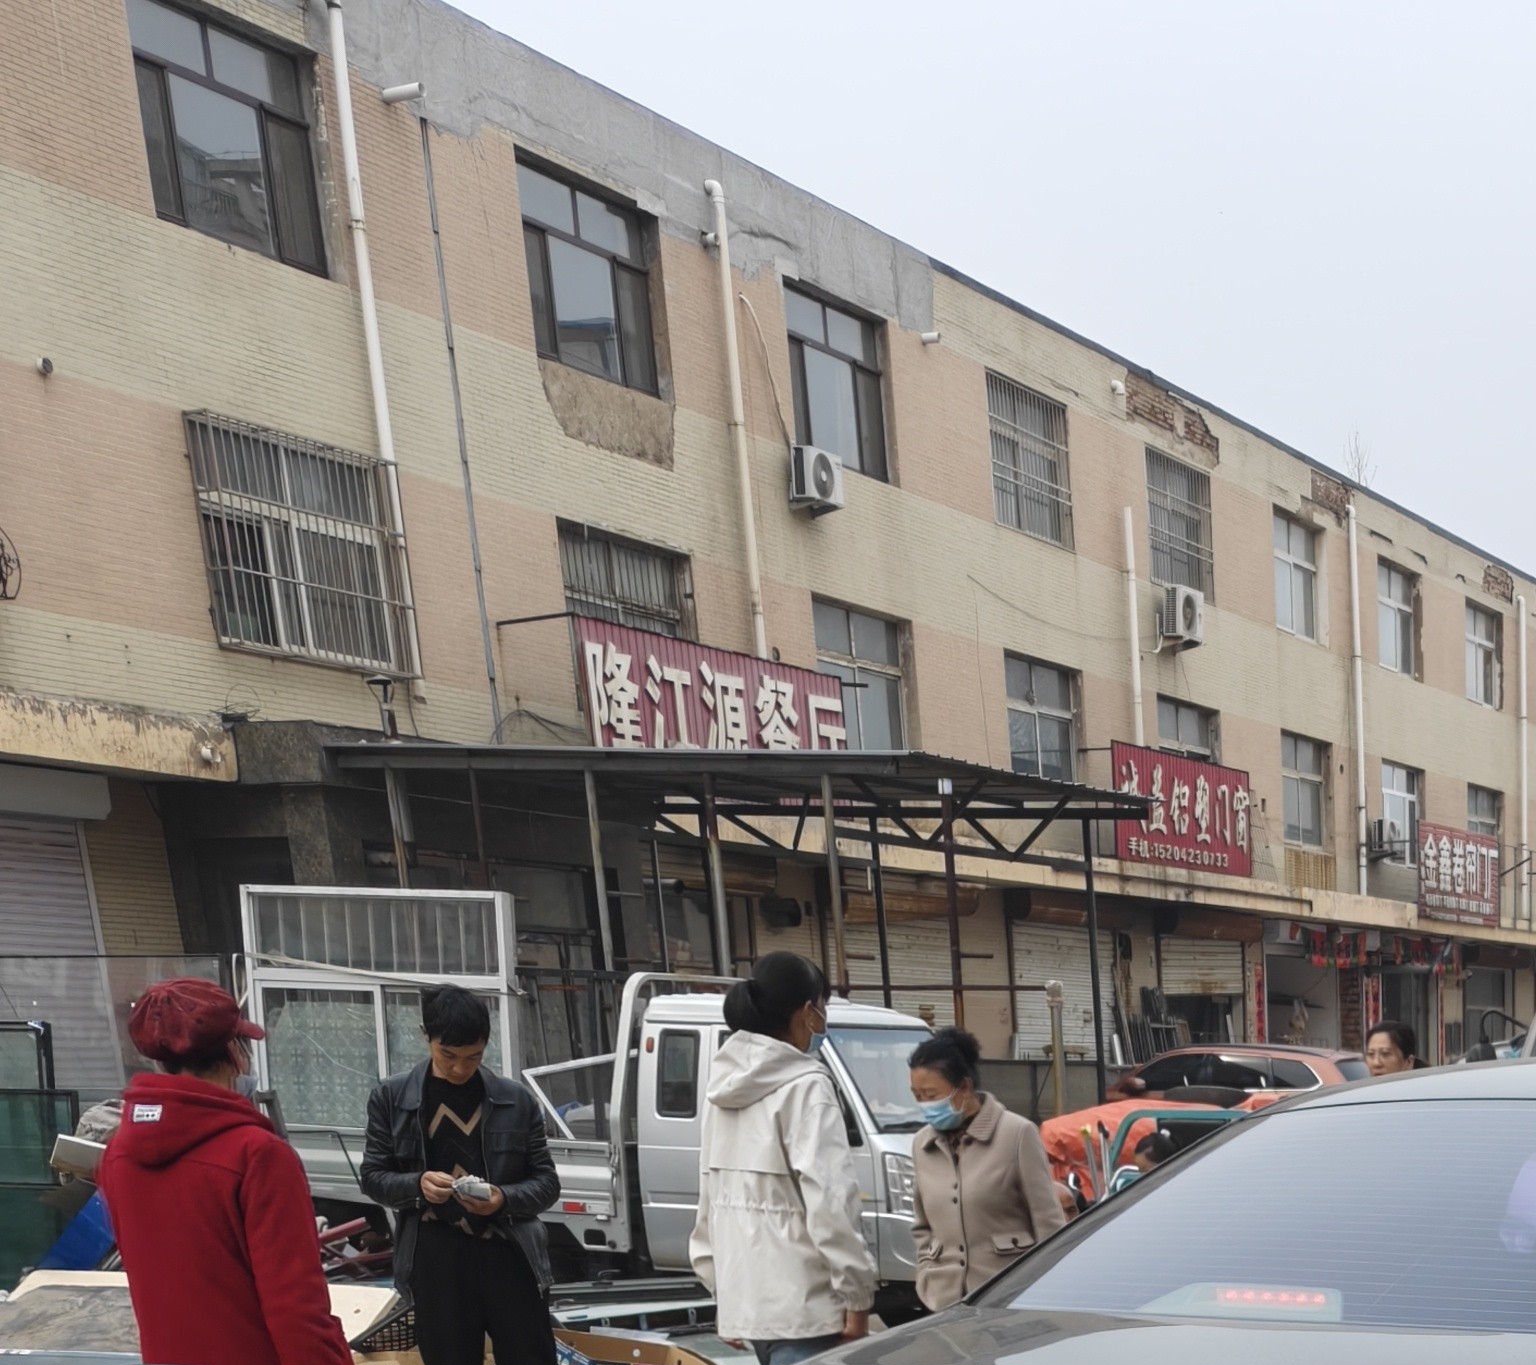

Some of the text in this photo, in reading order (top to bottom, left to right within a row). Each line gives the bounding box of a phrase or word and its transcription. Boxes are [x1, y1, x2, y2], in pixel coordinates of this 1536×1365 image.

[583, 640, 847, 750] 隆江源餐厅
